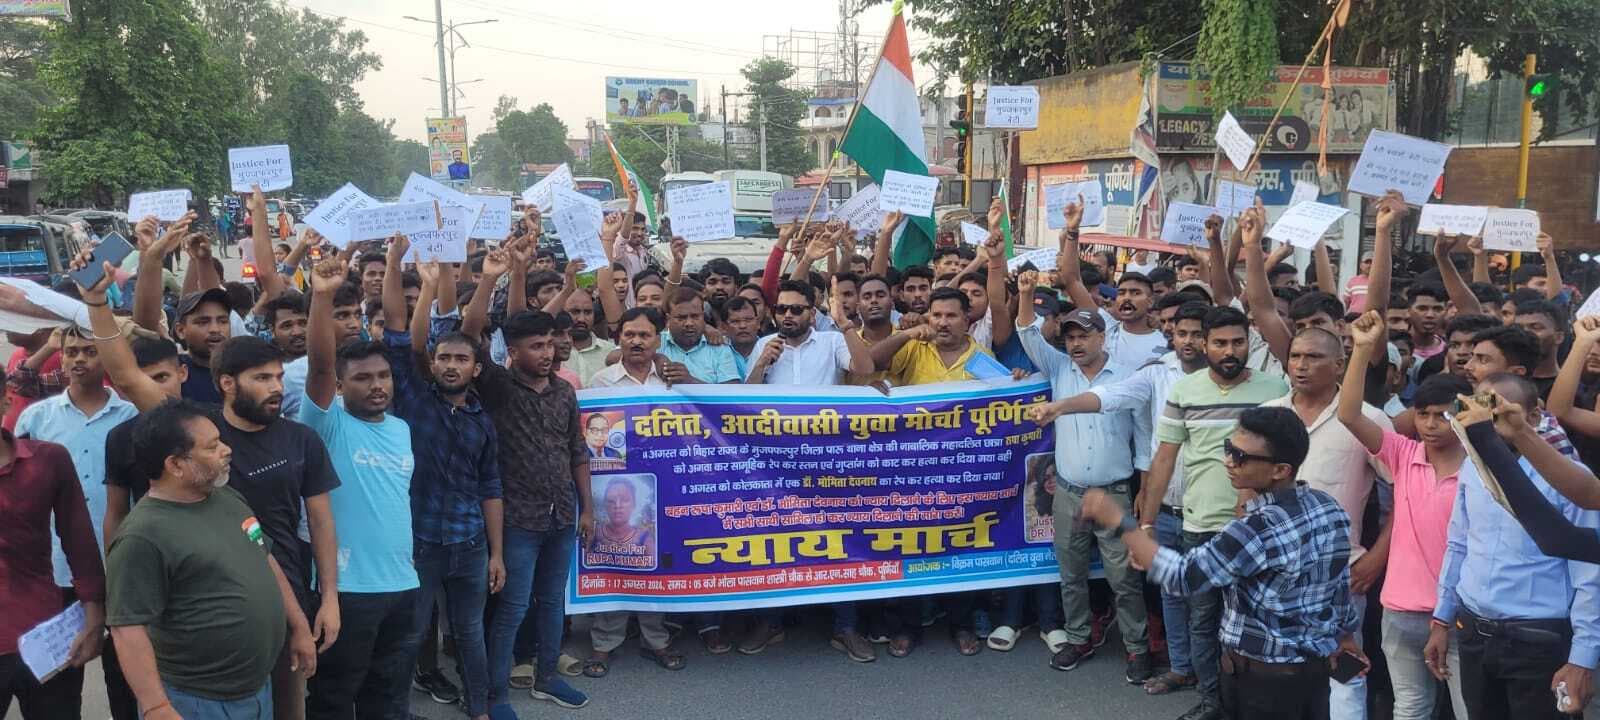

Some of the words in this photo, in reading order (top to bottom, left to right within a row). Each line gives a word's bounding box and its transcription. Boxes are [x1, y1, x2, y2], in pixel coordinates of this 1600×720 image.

[1021, 96, 1032, 104] For
[232, 160, 264, 170] Justice
[265, 158, 282, 166] For
[320, 202, 344, 223] Justice
[343, 192, 358, 204] For
[441, 217, 458, 226] For
[1493, 220, 1518, 228] Justice
[1520, 220, 1535, 228] For
[632, 409, 711, 439] दलित,
[721, 409, 843, 437] आदीवासी
[846, 413, 899, 439] युवा
[903, 404, 965, 432] मोर्चा
[649, 448, 676, 459] अगस्त
[680, 445, 691, 457] को
[693, 445, 715, 457] बिहार
[718, 446, 738, 456] राज्य
[740, 443, 750, 454] के
[801, 444, 824, 455] जिला
[846, 444, 866, 453] थाना
[868, 441, 883, 453] क्षेत्र
[886, 440, 898, 451] की
[900, 439, 939, 451] नाबालिक
[941, 437, 982, 450] महादलित
[983, 439, 1003, 448] छात्रा
[1021, 428, 1042, 446] कुमारी
[673, 462, 685, 474] को
[687, 464, 712, 474] अगवा
[714, 463, 729, 472] कर
[731, 457, 766, 474] सामूहिक
[769, 458, 780, 470] रेप
[782, 461, 797, 470] कर
[799, 461, 818, 470] स्तन
[820, 458, 834, 470] एवं
[836, 457, 865, 474] गुप्तांग
[867, 457, 879, 468] को
[882, 458, 900, 468] काट
[902, 458, 916, 467] कर
[918, 457, 937, 466] हत्या
[940, 456, 955, 465] कर
[957, 452, 975, 464] दिया
[977, 454, 995, 463] गया
[997, 449, 1012, 461] वही
[681, 485, 687, 494] 8
[689, 484, 716, 494] अगस्त
[718, 480, 730, 491] को
[732, 478, 773, 490] कोलकाता
[775, 477, 784, 488] में
[785, 479, 800, 488] एक
[816, 475, 847, 488] मोमिता
[880, 477, 891, 486] का
[894, 475, 905, 486] रेप
[907, 476, 921, 485] कर
[924, 475, 944, 485] हत्या
[946, 475, 961, 484] कर
[963, 471, 981, 482] दिया
[665, 505, 689, 517] बहन
[690, 504, 712, 516] रूपा
[713, 498, 743, 519] कुमारी
[744, 498, 760, 511] एवं
[778, 495, 811, 509] मोमिता
[812, 495, 847, 507] देवनाथ
[848, 494, 862, 506] को
[864, 496, 889, 506] न्याय
[890, 492, 921, 505] दिलाने
[922, 491, 935, 505] के
[936, 491, 956, 505] लिए
[957, 493, 974, 504] इस
[975, 490, 1000, 501] न्याय
[722, 515, 734, 529] में
[734, 514, 754, 529] सभी
[755, 512, 780, 527] साथी
[781, 510, 814, 526] सामिल
[814, 510, 826, 524] हो
[827, 513, 845, 523] कर
[845, 511, 871, 523] न्याय
[872, 507, 903, 521] दिलाने
[904, 506, 920, 520] की
[920, 506, 942, 520] मांग
[596, 544, 627, 554] Justice
[628, 543, 646, 554] For
[683, 528, 854, 566] न्याय
[863, 511, 1001, 556] मार्च
[587, 552, 614, 564] RUPA
[614, 554, 654, 567] KUMARI
[907, 560, 940, 573] आयोजक
[951, 556, 974, 570] विक्रम
[975, 554, 1002, 568] पासवान
[1030, 552, 1045, 568] युवा
[582, 575, 606, 588] दिनांक
[613, 579, 621, 588] 17
[622, 579, 646, 589] अगस्त
[667, 580, 686, 590] समय
[703, 576, 716, 588] बजे
[718, 575, 736, 588] भोला
[737, 575, 765, 586] पासवान
[767, 569, 787, 584] शास्त्री
[788, 568, 804, 582] चौक
[805, 568, 813, 581] से
